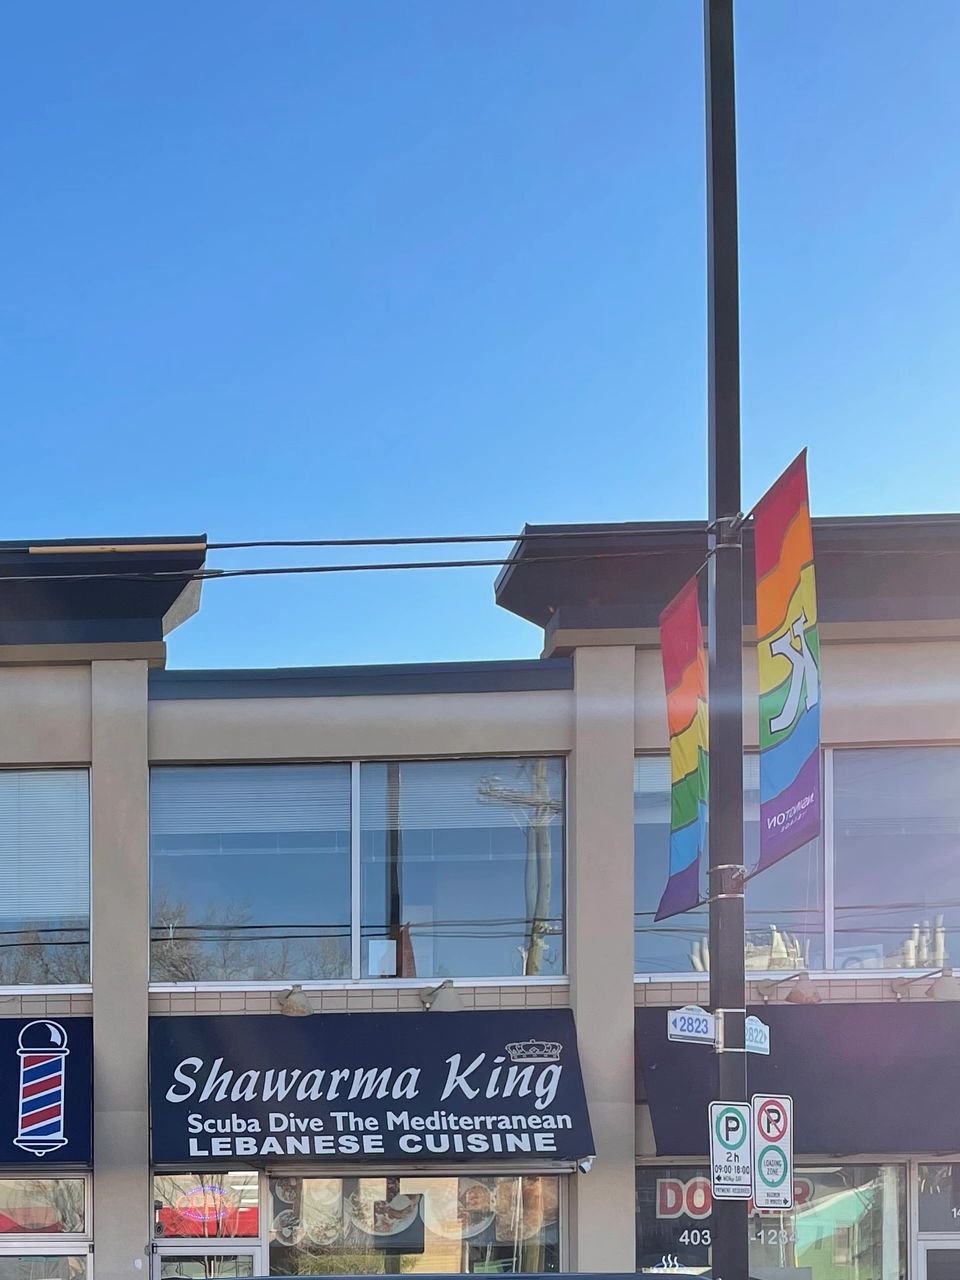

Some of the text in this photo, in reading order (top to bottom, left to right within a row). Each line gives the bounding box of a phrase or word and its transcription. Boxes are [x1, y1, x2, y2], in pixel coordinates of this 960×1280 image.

[679, 1016, 709, 1035] 2823
[165, 1053, 562, 1110] Shawarma King
[187, 1110, 572, 1134] Scuba Dive The Mediterranean
[725, 1116, 740, 1141] P
[189, 1132, 557, 1157] LEBANESE CUISINE
